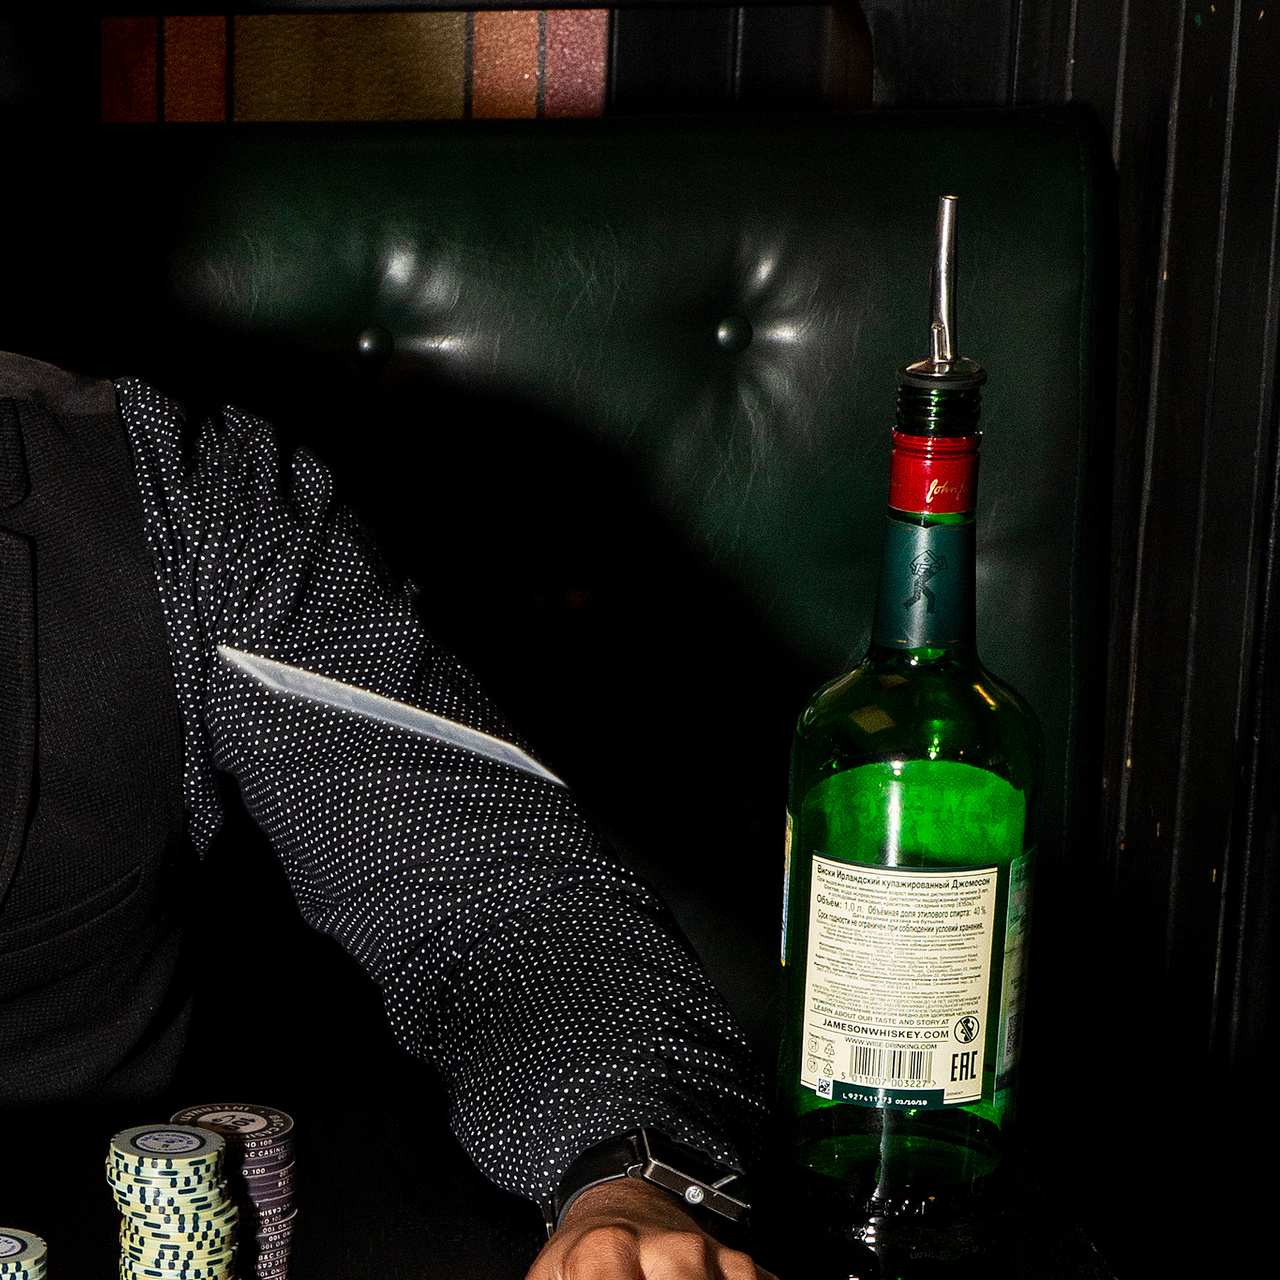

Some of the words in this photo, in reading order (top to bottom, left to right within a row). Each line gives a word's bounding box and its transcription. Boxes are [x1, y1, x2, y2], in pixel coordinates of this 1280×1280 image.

[817, 864, 836, 877] Виски
[836, 869, 880, 888] Ирландский
[881, 878, 950, 891] купажированный
[951, 876, 990, 890] Джемесон
[816, 893, 842, 909] Объём:
[845, 901, 855, 913] 1,0
[867, 905, 899, 917] Объёмная
[950, 909, 971, 920] спирта:
[935, 923, 958, 934] условий
[814, 1003, 833, 1014] LEARN
[834, 1009, 856, 1020] ABOUT
[857, 1014, 873, 1022] OUR
[875, 1017, 897, 1025] TASTE
[823, 1019, 949, 1039] JAMESONWHISKEY.COM
[950, 1050, 978, 1082] EAC
[841, 1072, 846, 1080] 5
[852, 1074, 886, 1086] 011007
[891, 1080, 927, 1088] 003227
[258, 1146, 285, 1157] CASINO
[259, 1206, 282, 1217] CASIN
[258, 1252, 274, 1261] B&C
